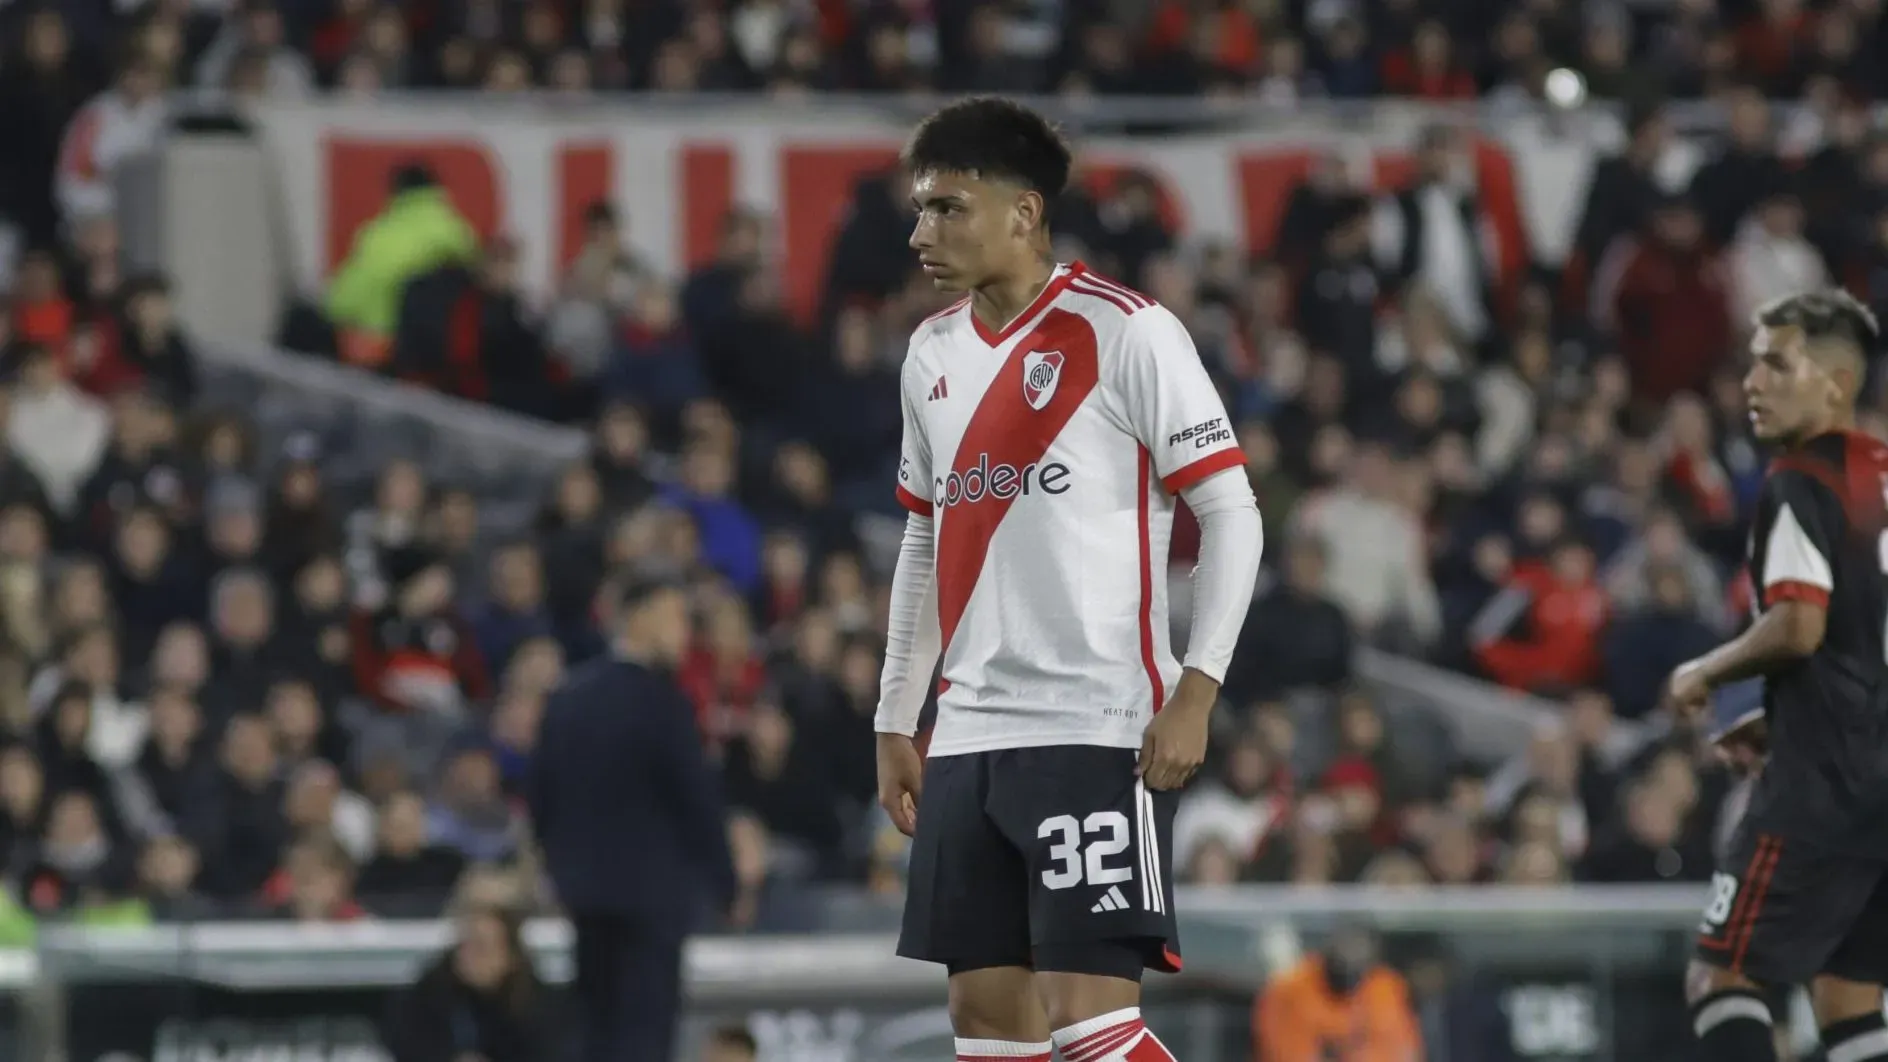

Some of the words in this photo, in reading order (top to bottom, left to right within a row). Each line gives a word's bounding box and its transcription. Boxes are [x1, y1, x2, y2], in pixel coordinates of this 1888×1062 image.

[1169, 418, 1223, 447] ASSIST
[1195, 429, 1231, 449] CARD
[934, 452, 1072, 509] codere
[1037, 811, 1133, 890] 32
